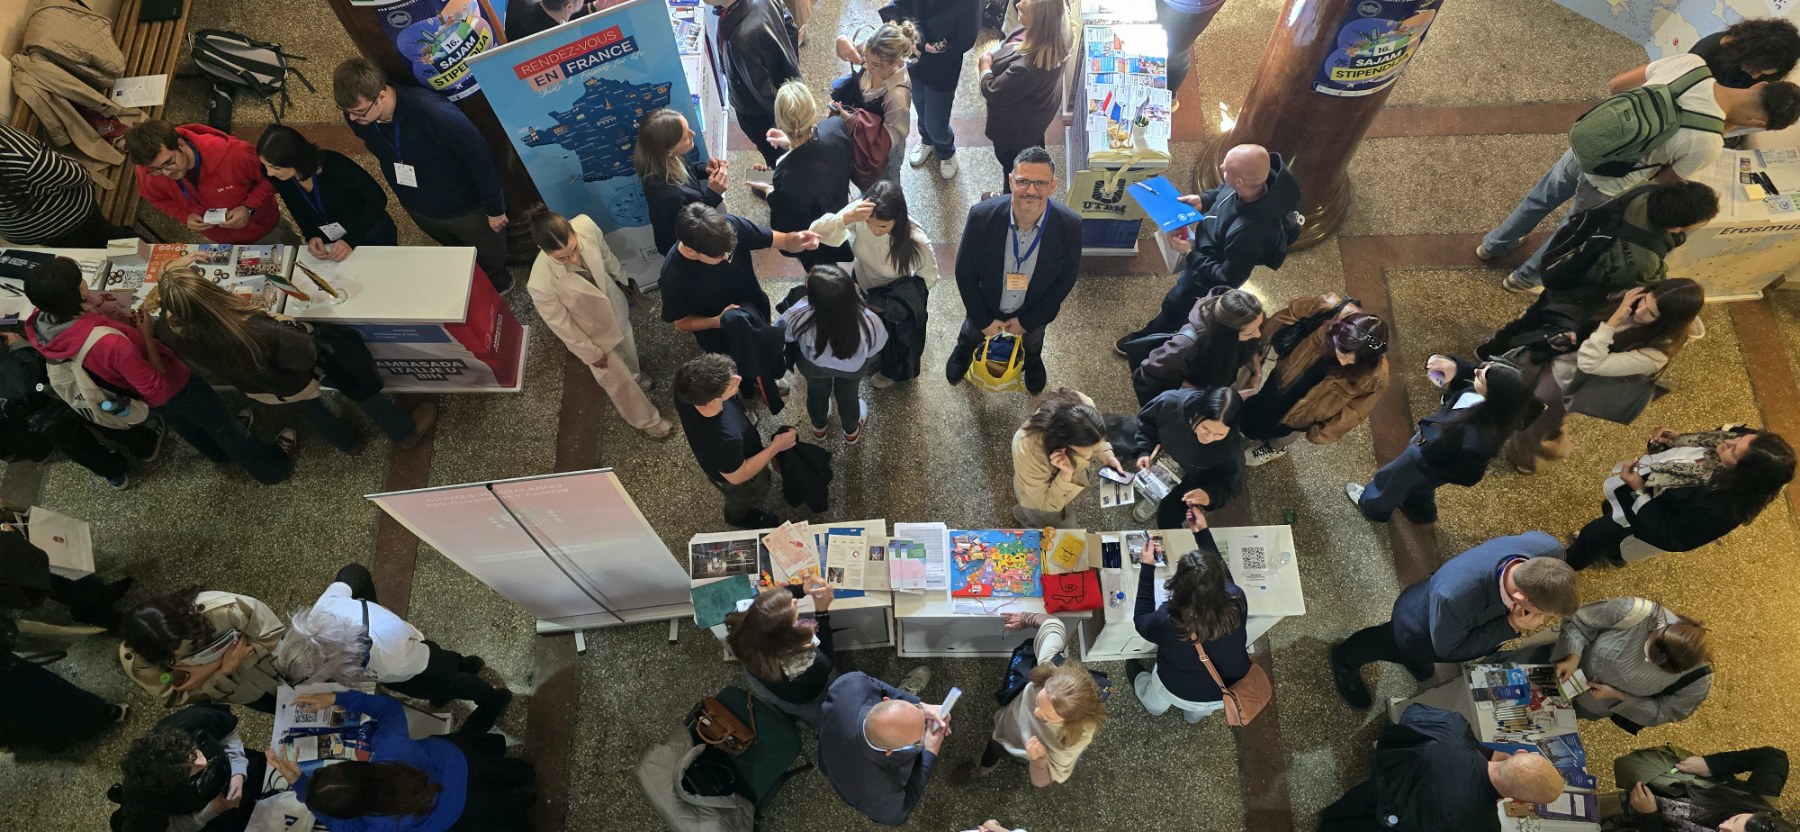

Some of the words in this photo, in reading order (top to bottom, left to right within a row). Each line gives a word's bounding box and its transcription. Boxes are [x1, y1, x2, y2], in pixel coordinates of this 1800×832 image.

[439, 35, 477, 70] SAJAM
[445, 39, 460, 50] 16.
[520, 30, 618, 76] RENDEZ-VOUS
[1377, 45, 1392, 54] 16.
[434, 34, 489, 87] STIPEIJA
[534, 69, 559, 87] EN
[566, 40, 634, 74] FRANCE
[1335, 52, 1409, 79] STIPENDIJA
[1355, 50, 1403, 67] SAJAM
[1082, 200, 1128, 213] UTBM
